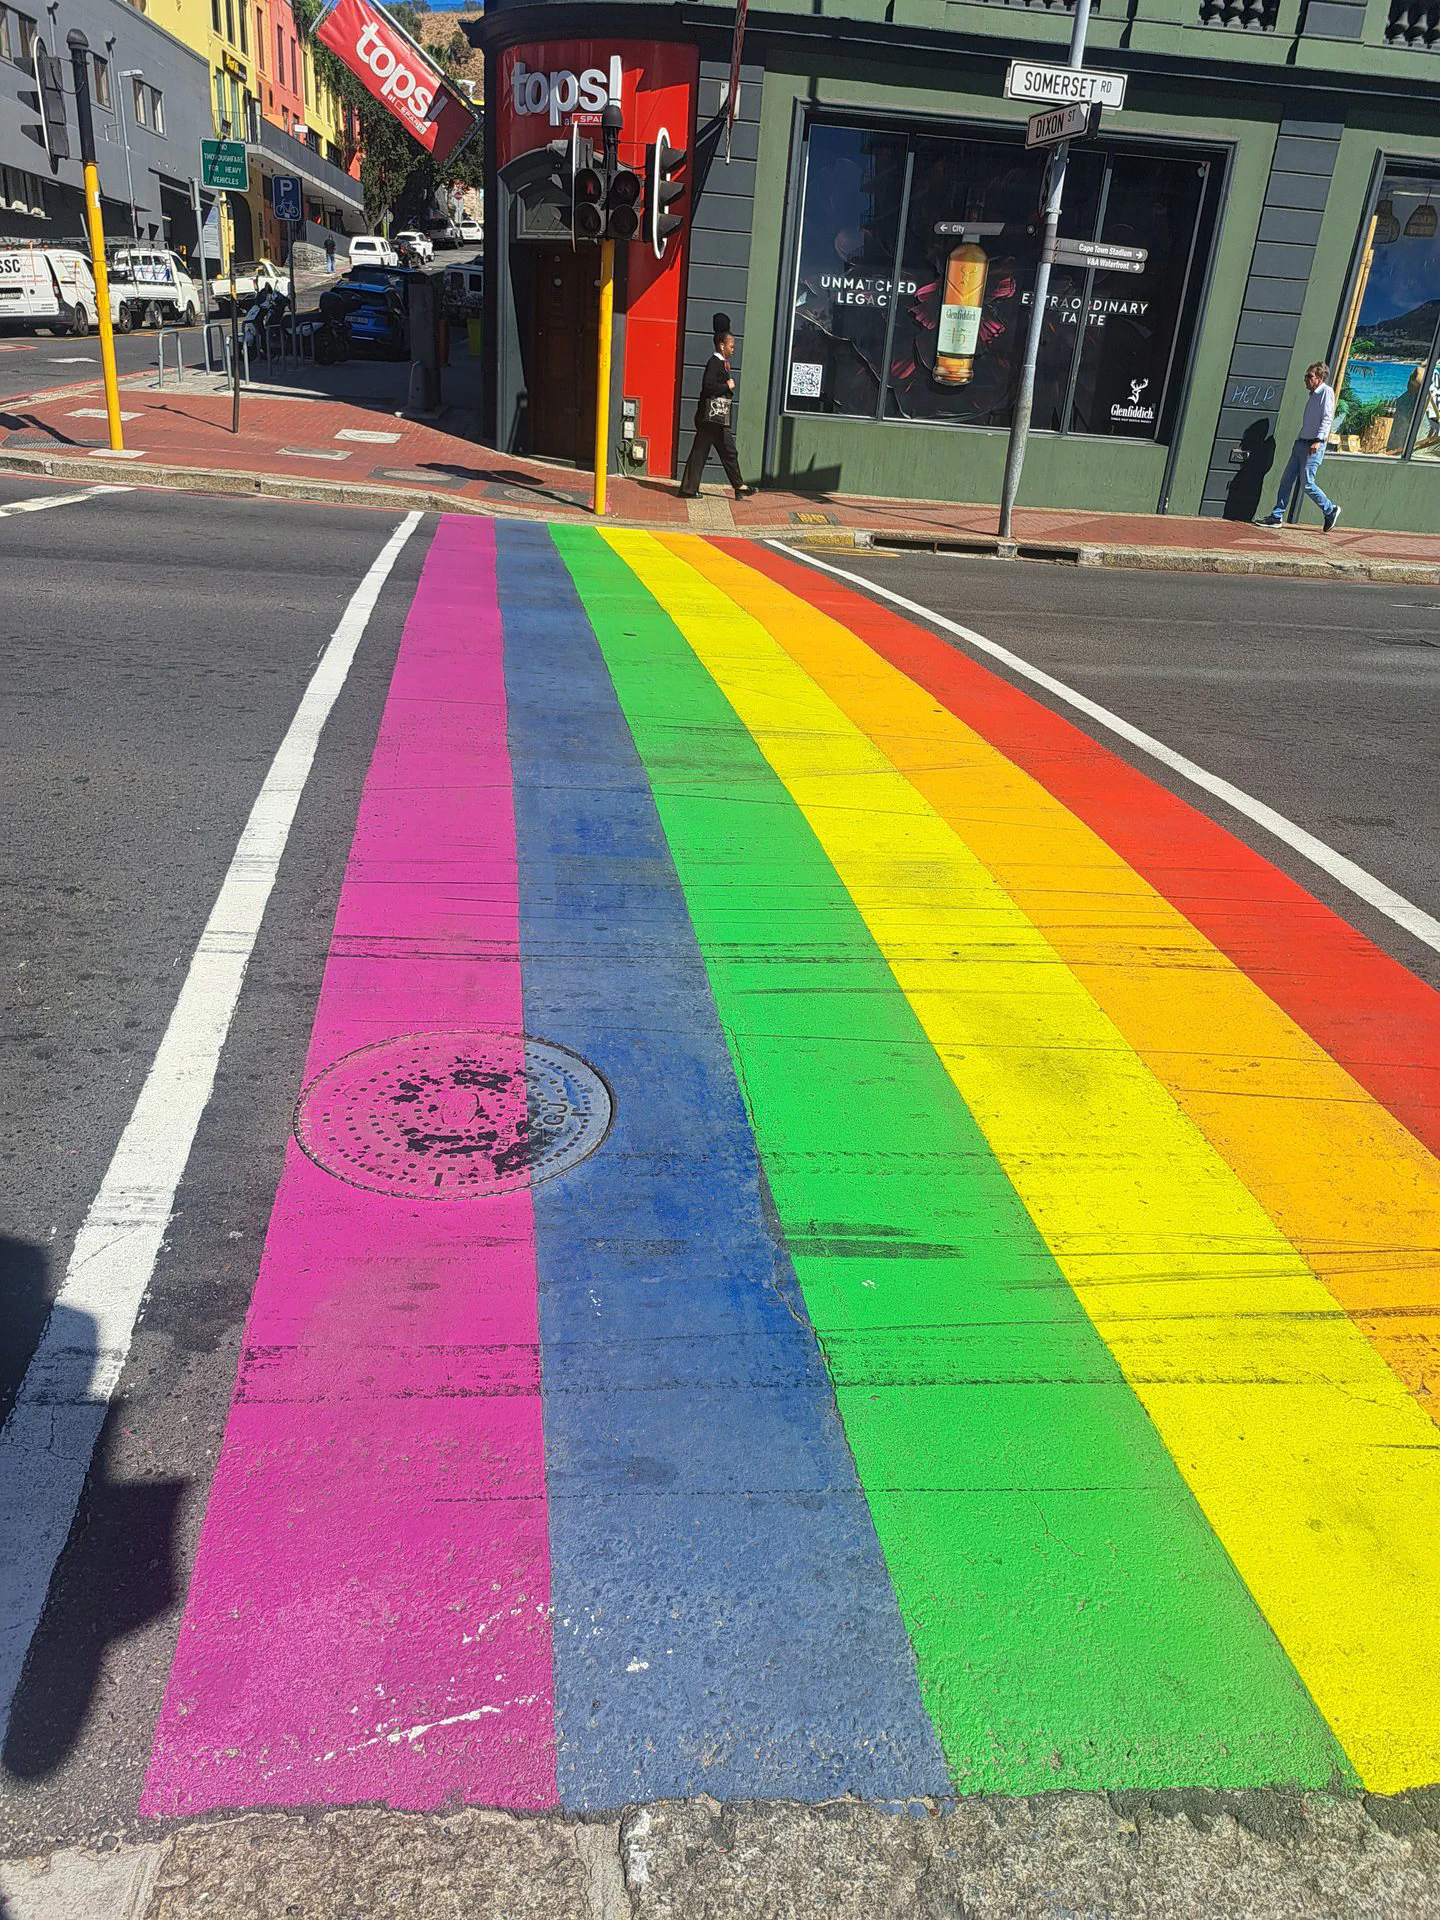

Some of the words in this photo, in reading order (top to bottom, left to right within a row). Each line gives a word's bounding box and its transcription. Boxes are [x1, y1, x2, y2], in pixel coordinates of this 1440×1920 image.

[1024, 71, 1097, 99] SOMERSET
[1100, 80, 1113, 94] RD
[580, 115, 603, 123] SPA
[1035, 112, 1065, 139] DIXON
[1067, 109, 1077, 123] ST
[203, 152, 244, 164] THOROUGHFARE
[208, 164, 219, 173] FOR
[224, 165, 242, 175] HEAVY
[212, 175, 239, 186] VEHICLES
[279, 179, 293, 197] P
[952, 224, 966, 235] City
[1078, 243, 1094, 254] Cape
[1094, 245, 1109, 255] Town
[1108, 247, 1133, 259] Stadium
[1086, 257, 1099, 266] V&A
[1099, 258, 1130, 270] Waterfront
[821, 276, 917, 294] UNMATCHED
[837, 291, 892, 307] LEGAC
[1021, 293, 1149, 314] ERAODINARY
[1061, 311, 1107, 326] TATE
[1110, 403, 1154, 420] Glenfiddich
